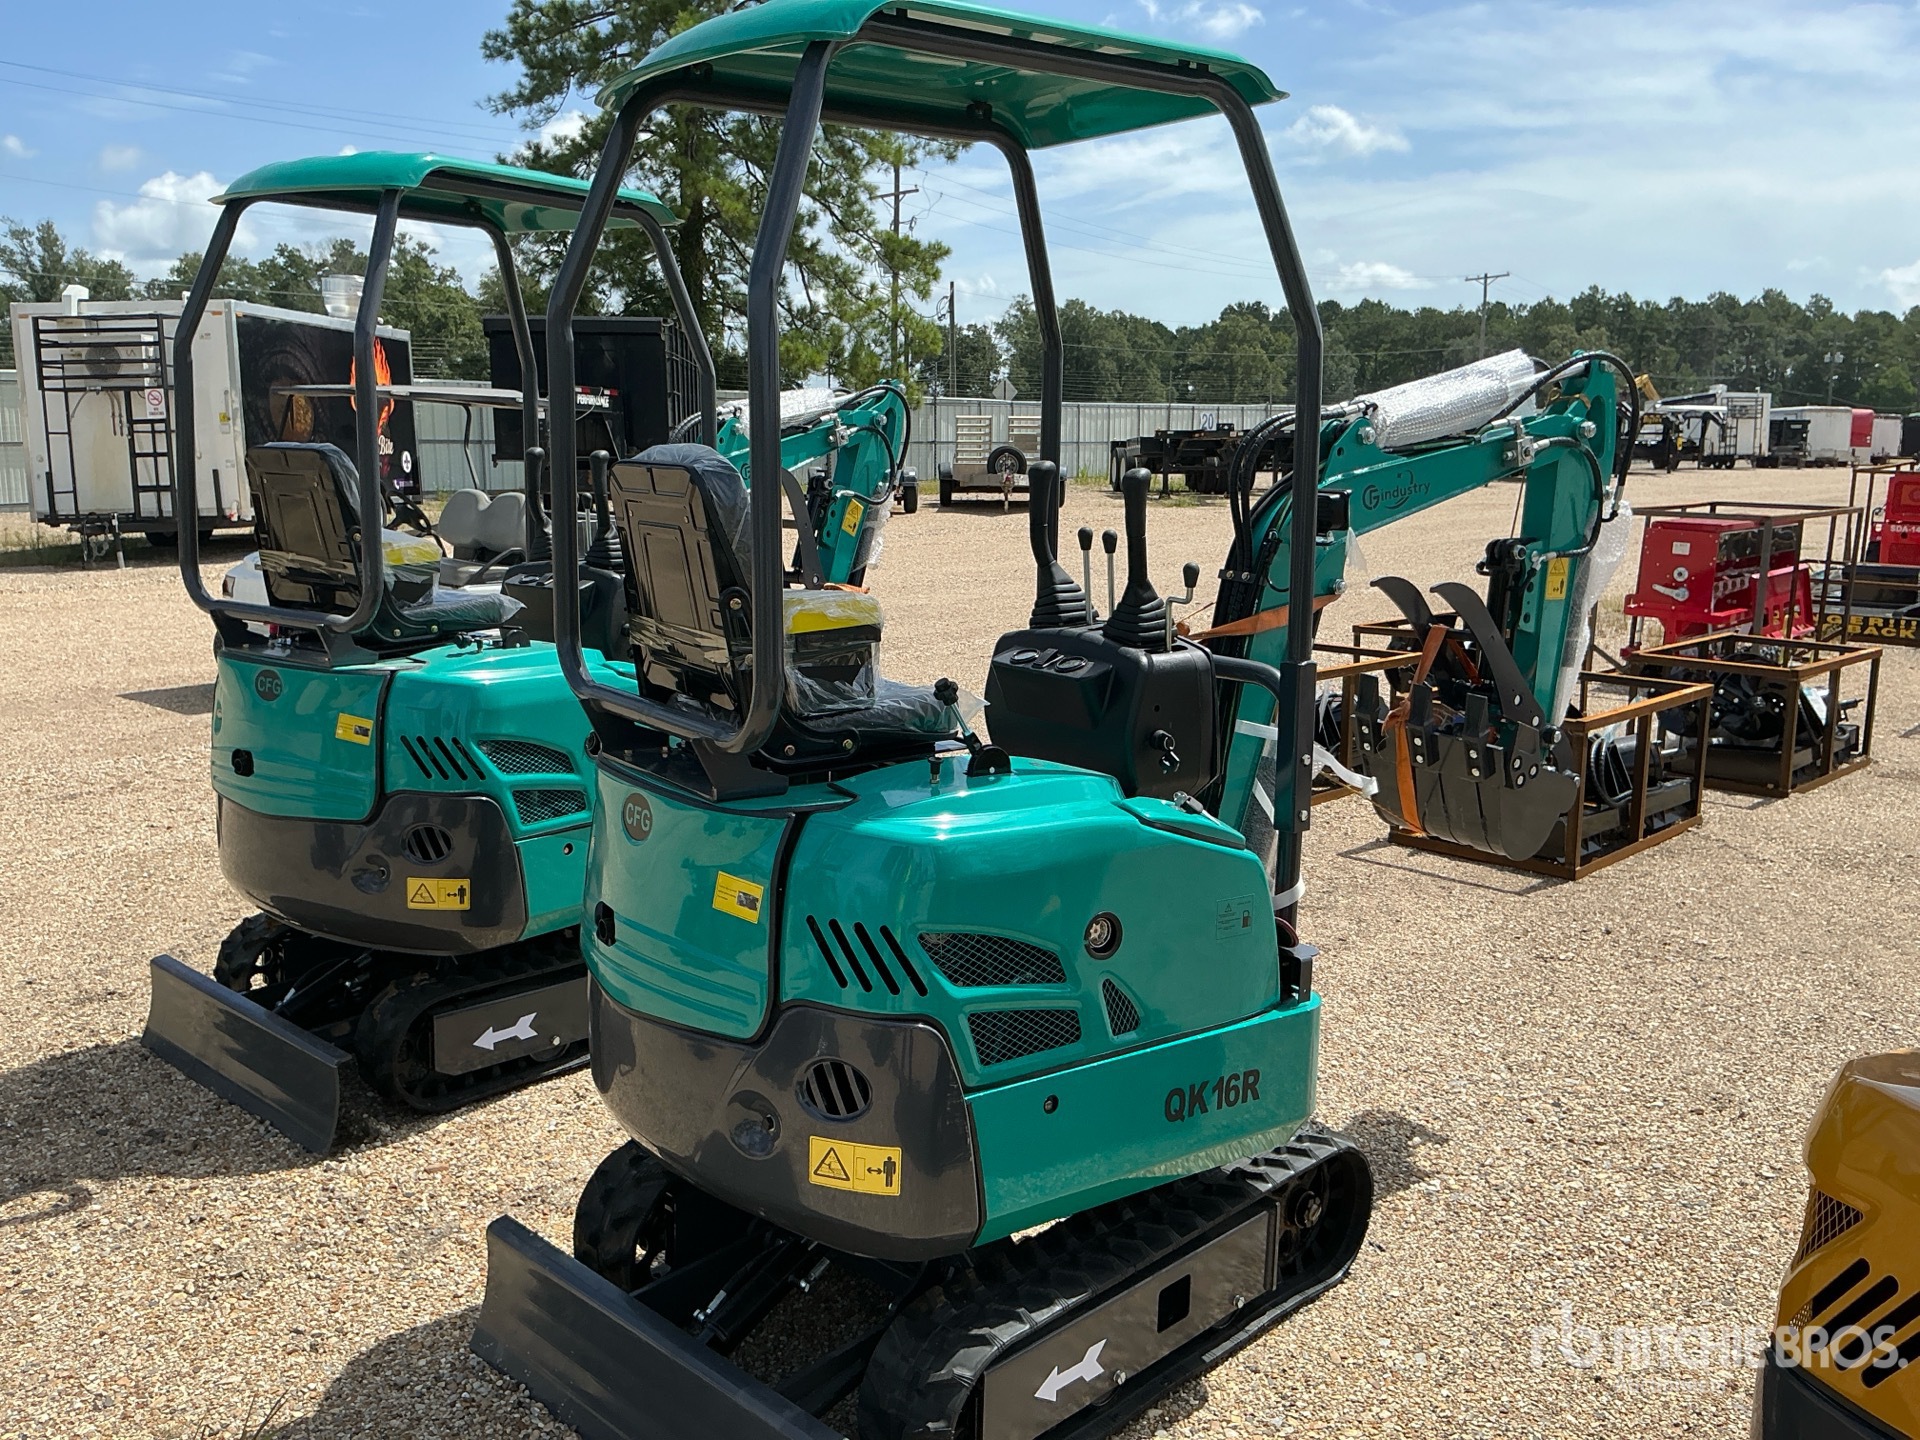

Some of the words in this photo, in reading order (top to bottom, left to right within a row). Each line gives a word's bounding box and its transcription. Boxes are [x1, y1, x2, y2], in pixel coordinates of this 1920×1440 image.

[1201, 413, 1214, 430] 20
[1847, 624, 1916, 639] BACK
[257, 676, 281, 694] CFG
[625, 802, 651, 832] CFG
